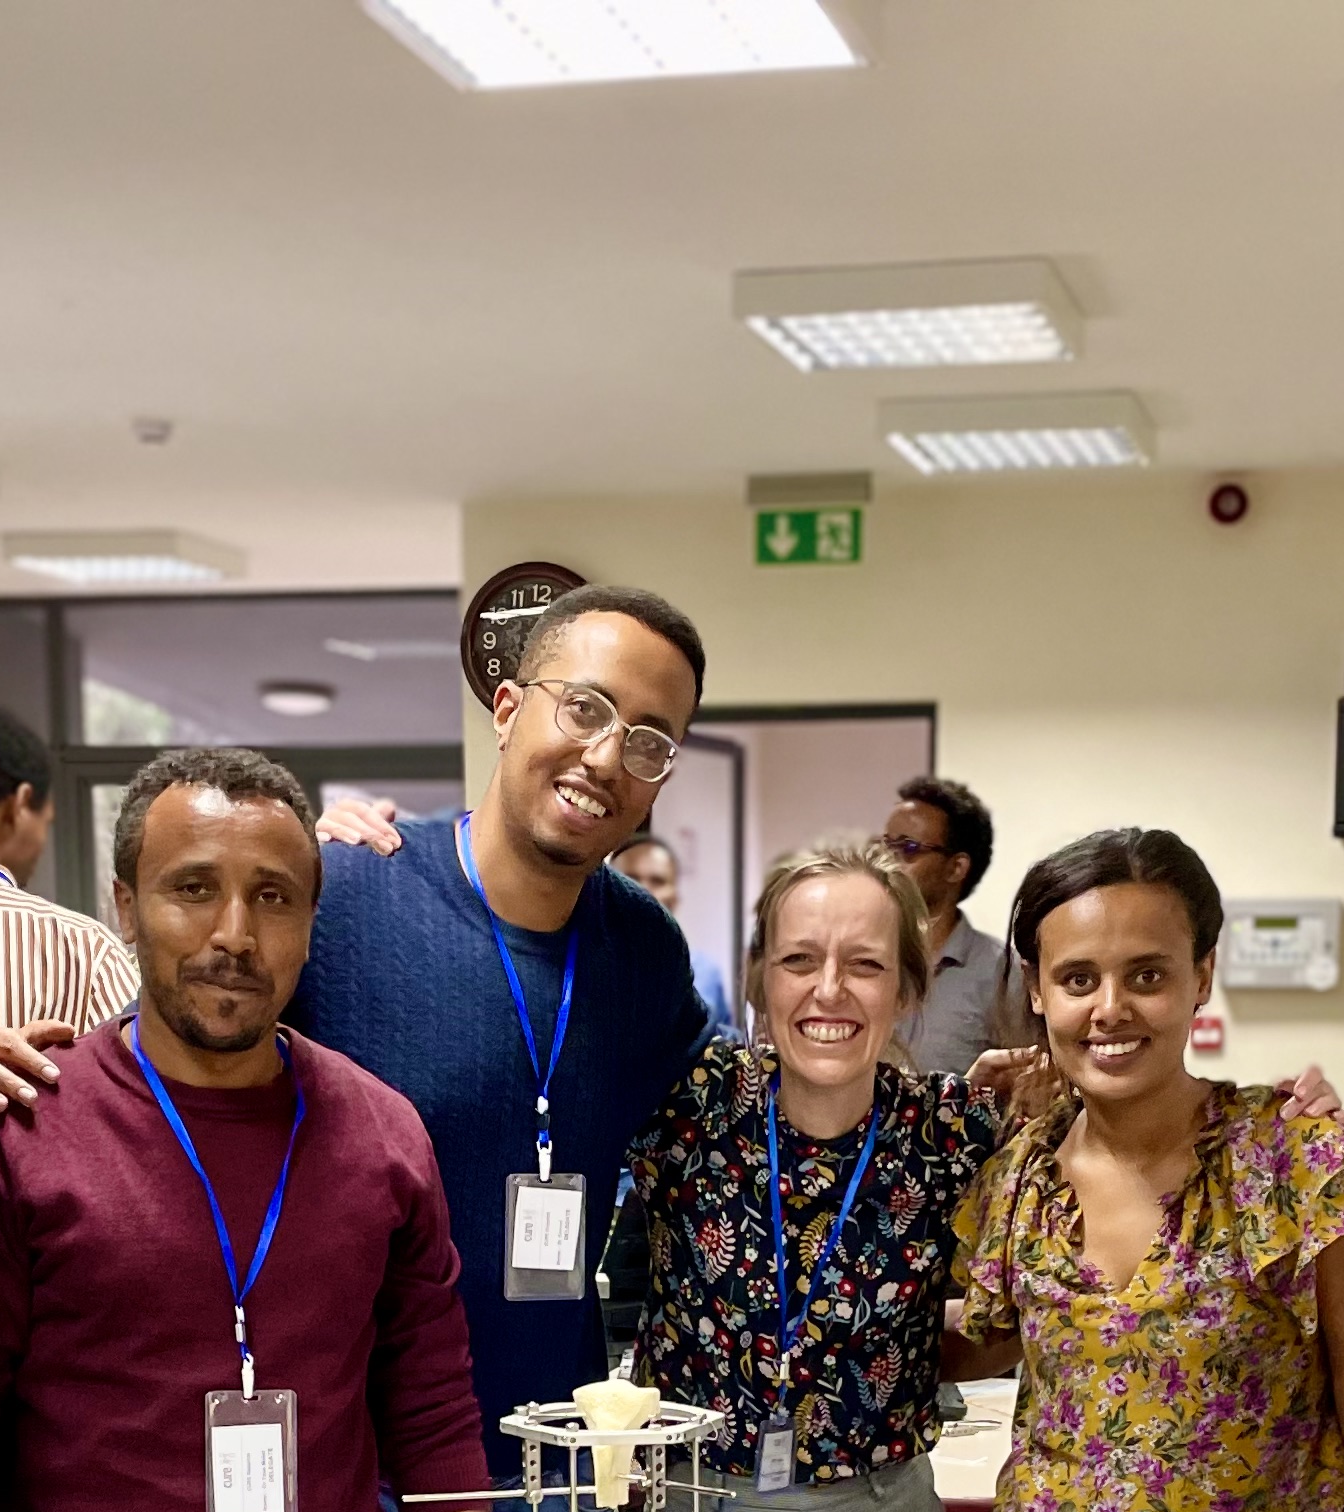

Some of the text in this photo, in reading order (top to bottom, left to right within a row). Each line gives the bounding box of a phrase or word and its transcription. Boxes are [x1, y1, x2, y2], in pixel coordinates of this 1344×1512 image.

[511, 589, 525, 608] 11
[532, 583, 552, 603] 12
[483, 632, 497, 650] 9
[486, 658, 501, 677] 8
